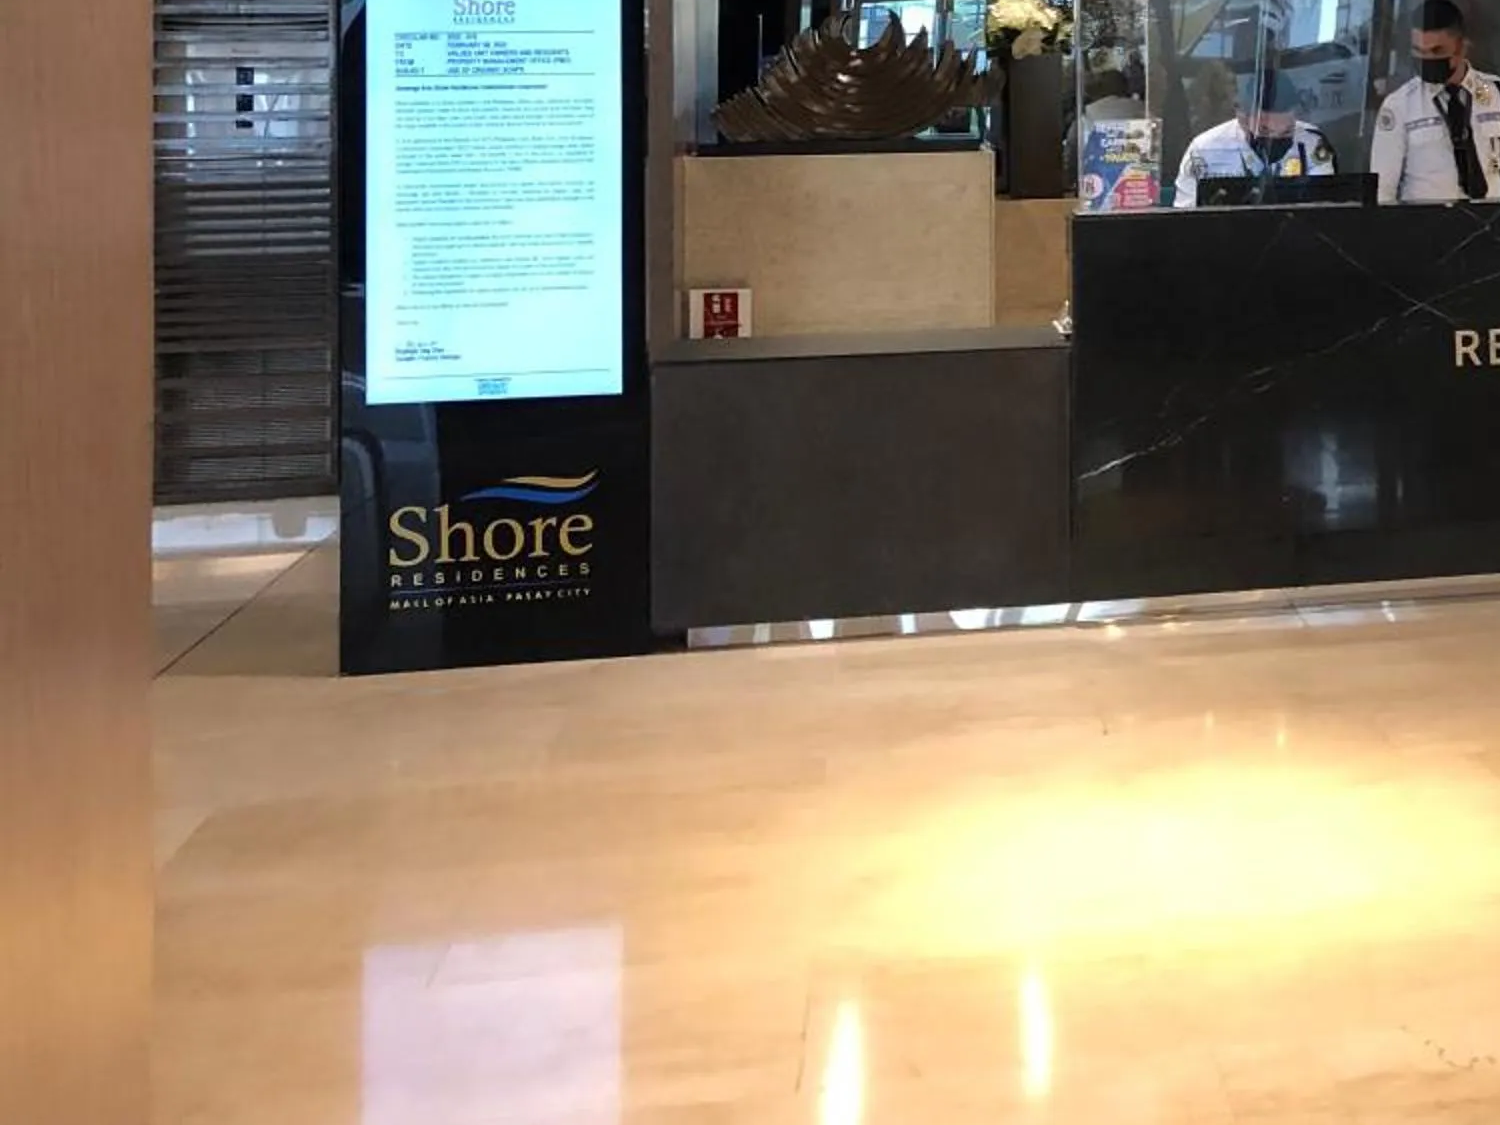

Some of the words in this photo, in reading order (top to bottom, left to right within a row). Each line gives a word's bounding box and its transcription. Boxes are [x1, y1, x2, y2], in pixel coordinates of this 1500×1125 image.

[389, 503, 594, 567] Shore
[390, 562, 591, 588] RESIDENCES
[389, 598, 430, 611] MALL
[434, 597, 454, 608] OF
[459, 594, 495, 605] ASIA
[557, 587, 592, 598] CITY
